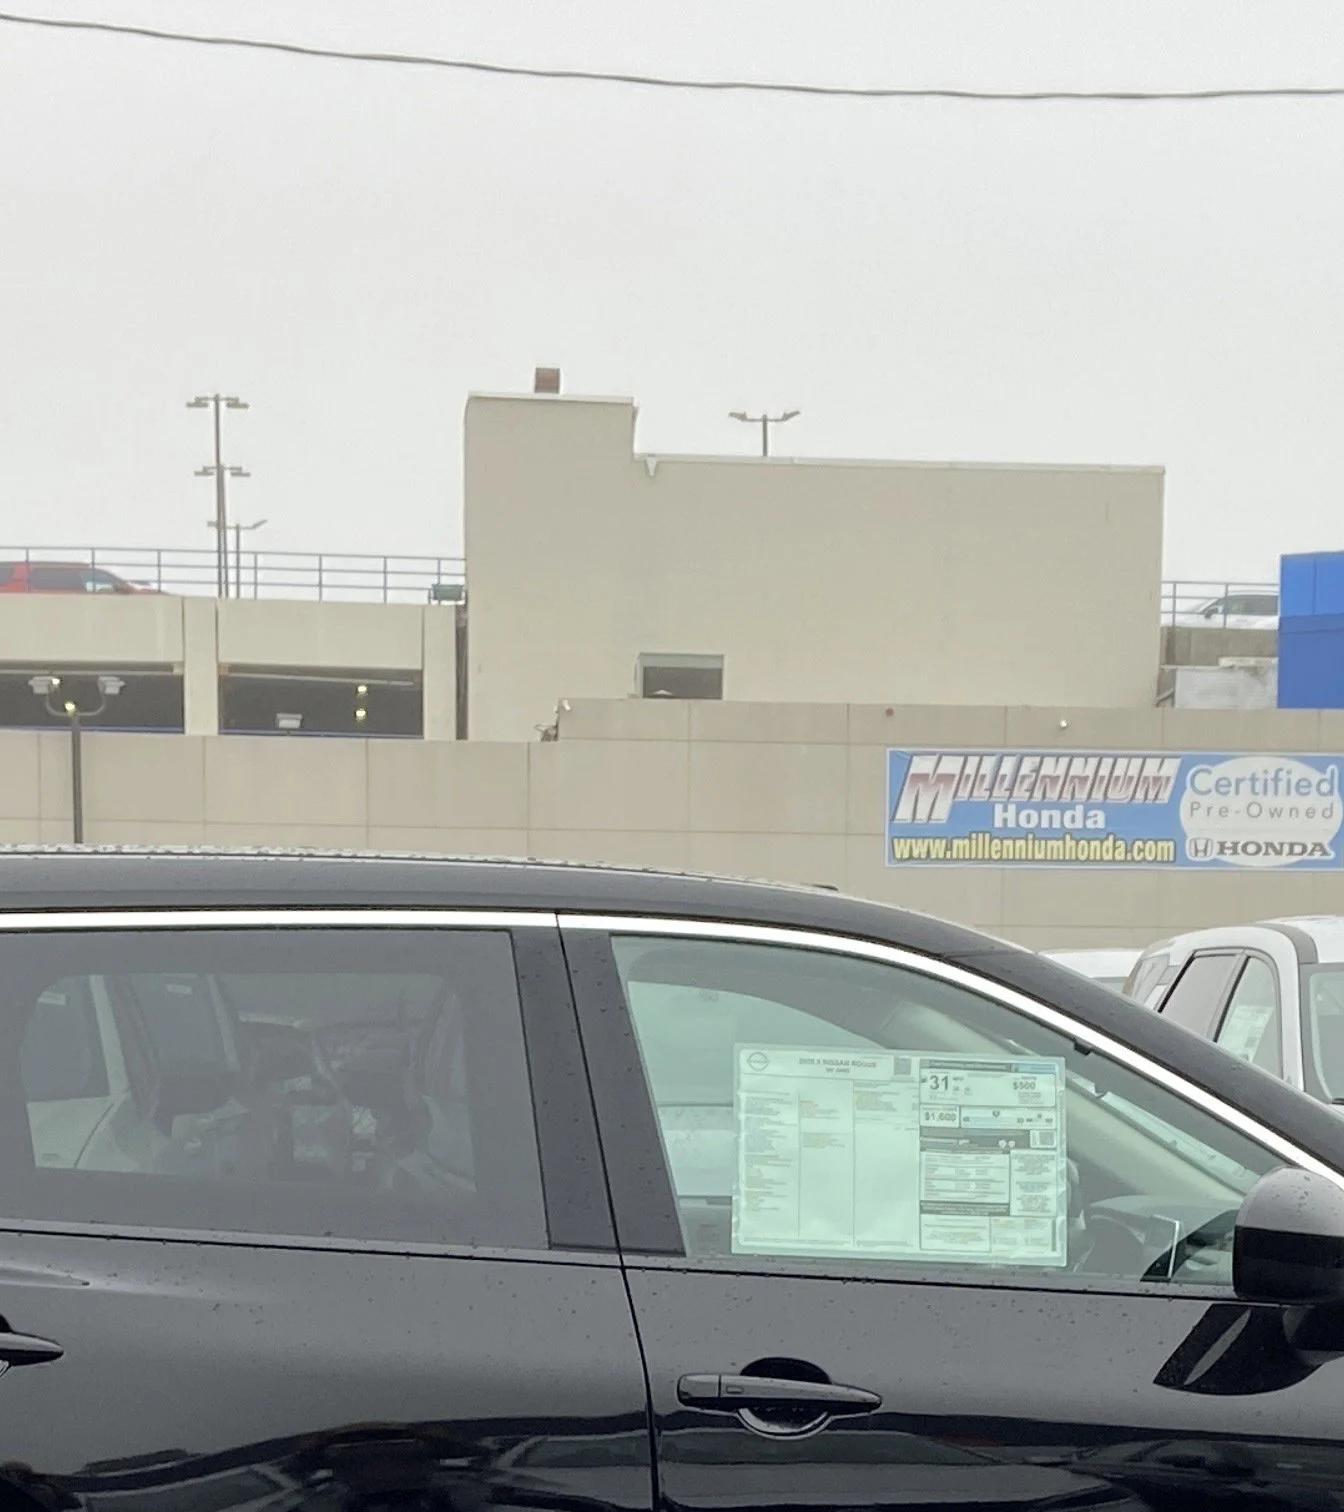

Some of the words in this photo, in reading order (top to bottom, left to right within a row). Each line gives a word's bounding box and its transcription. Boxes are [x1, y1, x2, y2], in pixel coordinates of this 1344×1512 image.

[892, 753, 1182, 824] MILLENNIUM
[1189, 766, 1336, 797] Certified
[993, 803, 1106, 829] Honda
[1189, 801, 1335, 819] Pre-Owned
[892, 832, 1176, 862] www.millenniumhonda.com
[1216, 841, 1332, 858] HONDA
[930, 1075, 949, 1091] 31
